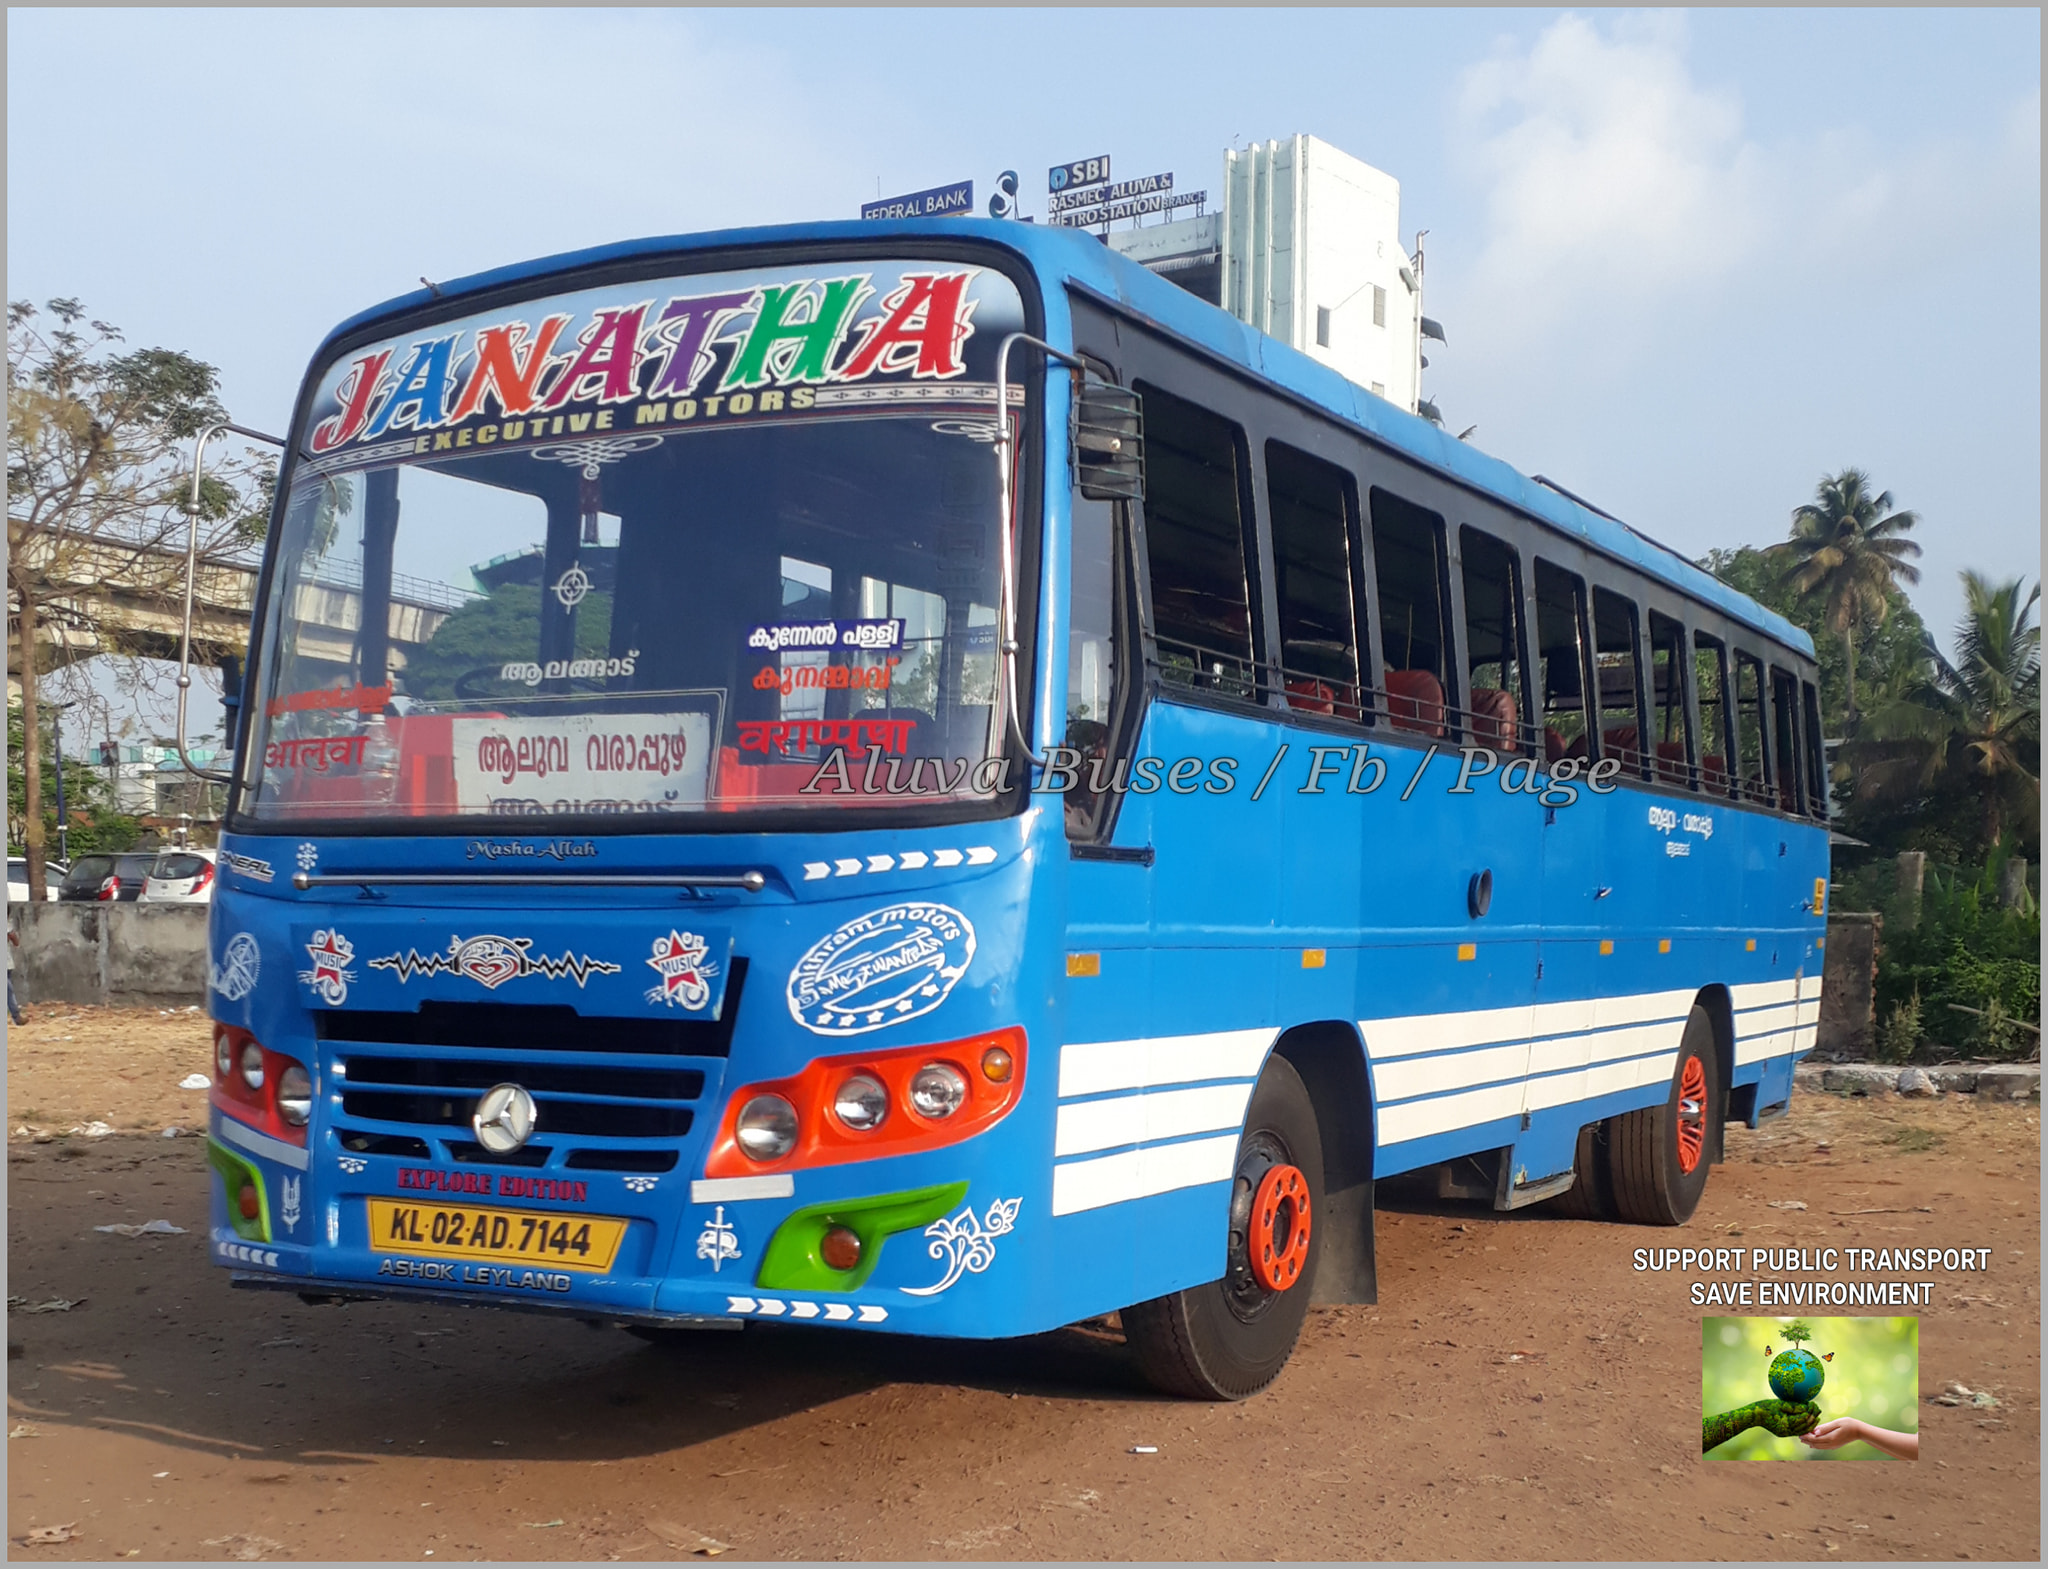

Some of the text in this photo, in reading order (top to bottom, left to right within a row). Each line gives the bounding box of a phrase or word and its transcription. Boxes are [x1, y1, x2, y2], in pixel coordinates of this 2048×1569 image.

[1072, 156, 1108, 184] SBI
[865, 189, 967, 220] FEDERAL BANK
[1049, 173, 1171, 212] RASMEC ALUVA &
[1100, 196, 1160, 221] STATION
[1161, 190, 1206, 209] BRANCH
[312, 266, 981, 454] JANATHA
[414, 386, 816, 455] EXECUTIVE MOTORS
[843, 618, 901, 648] പള്ളി
[501, 649, 641, 687] ആലങ്ങാട്
[478, 735, 569, 785] ആലുവ
[466, 839, 599, 862] Masha Allah
[881, 907, 961, 941] motors
[314, 952, 345, 969] MUSIC
[660, 954, 700, 974] MUSIC
[398, 1167, 588, 1202] EXPLORE EDITION
[378, 1259, 572, 1292] ASHOK LEYLAND
